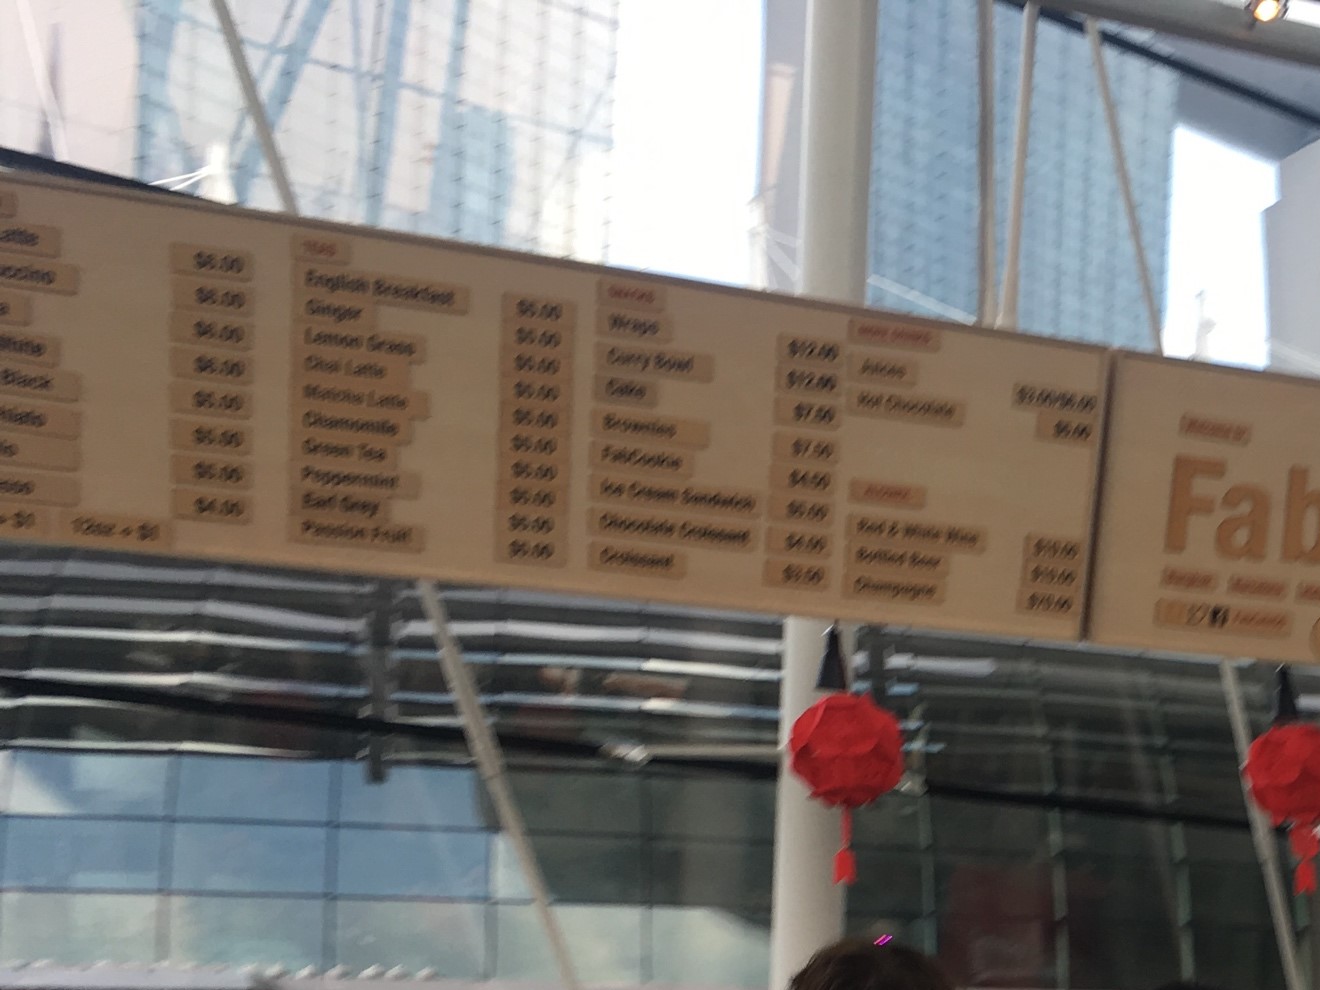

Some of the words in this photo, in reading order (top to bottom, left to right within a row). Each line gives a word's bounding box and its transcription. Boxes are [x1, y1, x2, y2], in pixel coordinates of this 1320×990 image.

[304, 268, 370, 293] English
[373, 279, 455, 304] Breakfast
[304, 299, 363, 322] Ginger
[304, 327, 363, 348] Lemon
[608, 313, 659, 336] Wraps
[606, 347, 651, 371] Curry
[654, 352, 694, 373] Bowl
[857, 391, 884, 409] Hot
[885, 393, 955, 419] Chocolate
[857, 517, 885, 536] Red
[945, 526, 978, 546] Wine
[908, 551, 941, 570] Beer
[854, 575, 937, 601] Champagne
